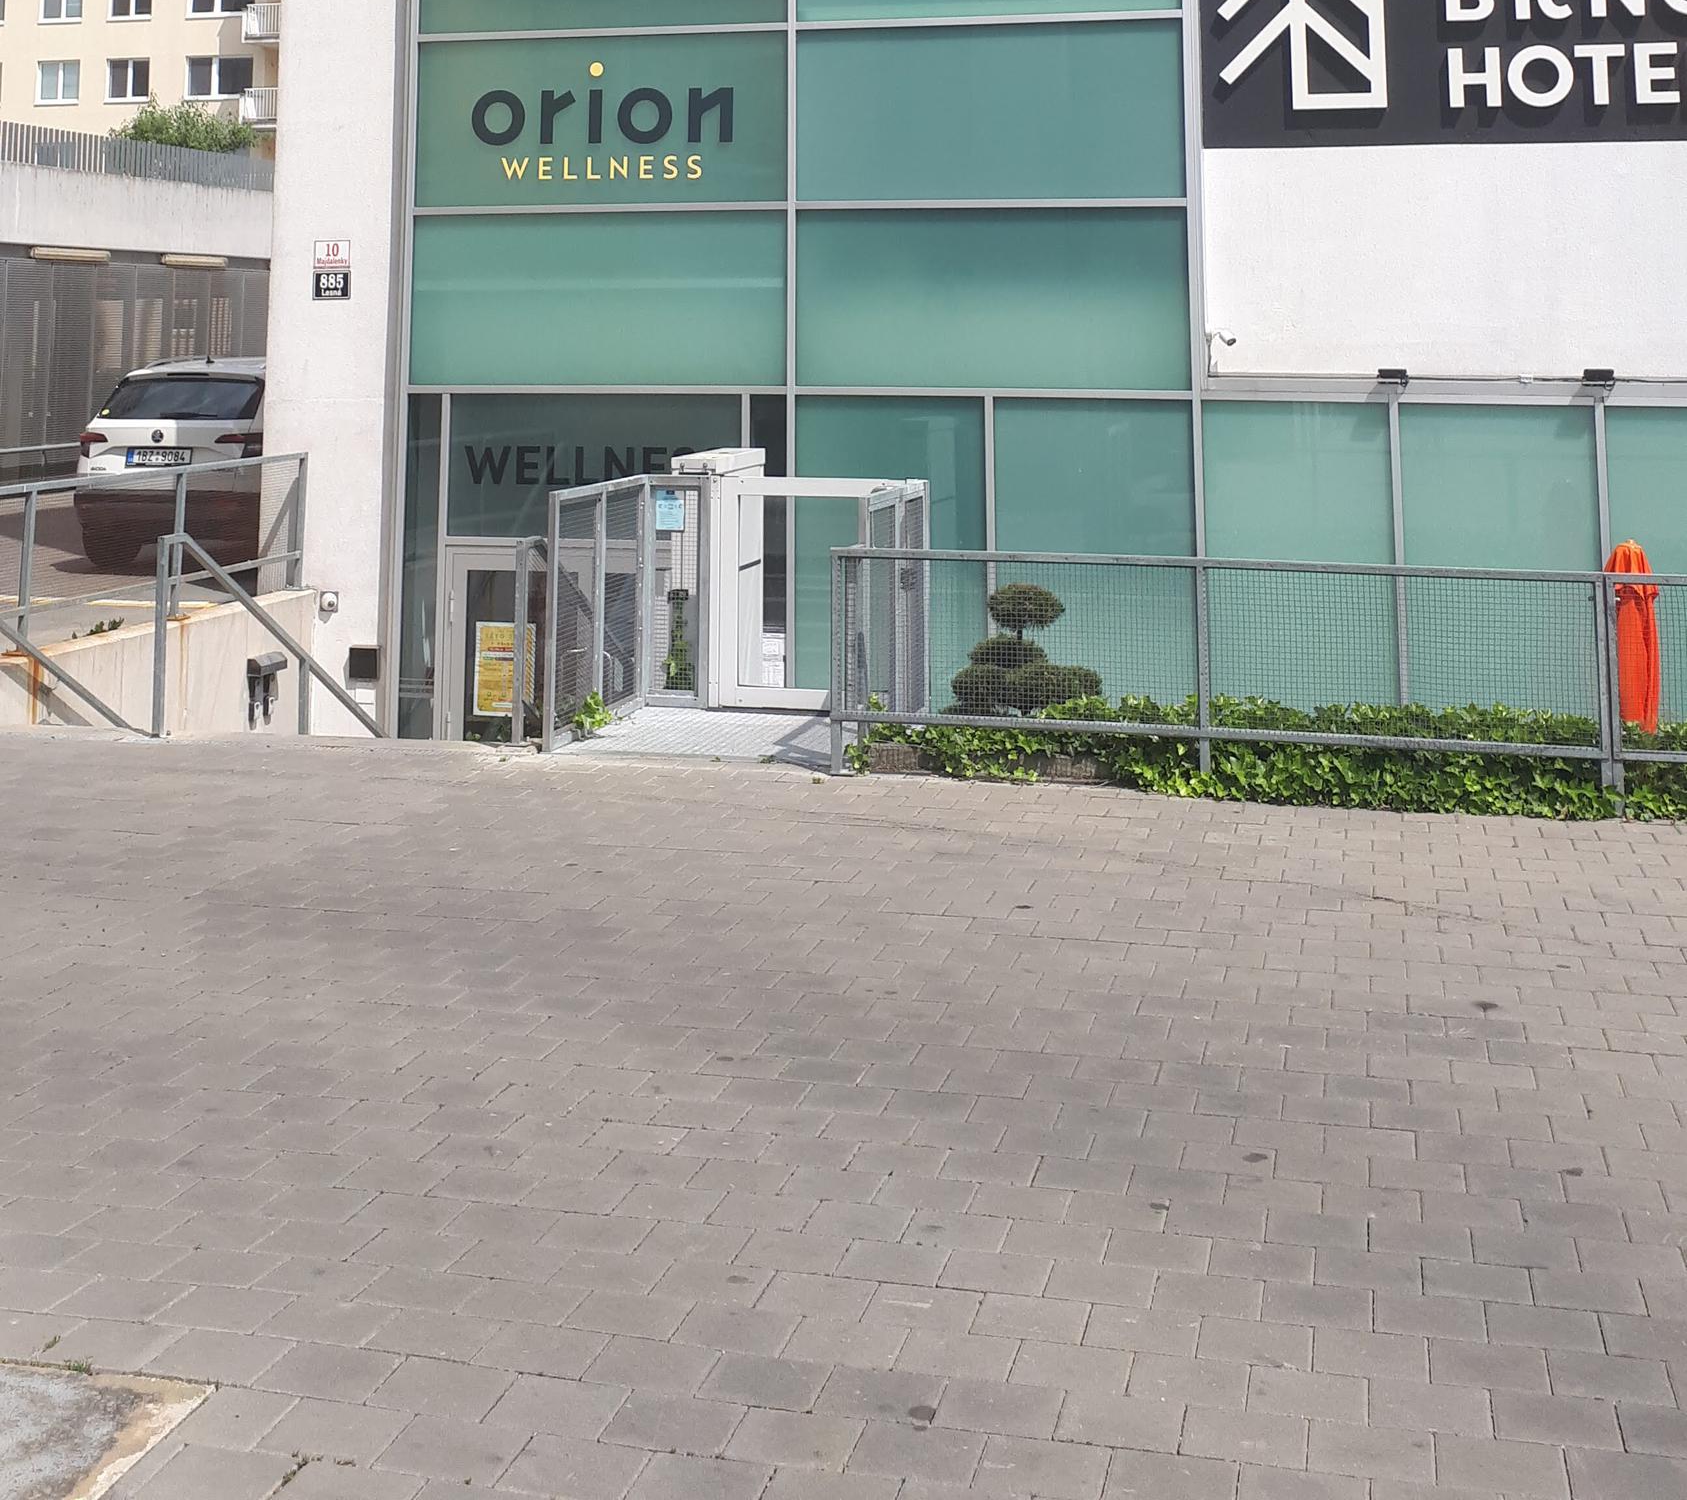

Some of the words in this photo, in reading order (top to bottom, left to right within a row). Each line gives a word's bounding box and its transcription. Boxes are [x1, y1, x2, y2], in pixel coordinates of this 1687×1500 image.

[471, 60, 734, 146] orion
[501, 154, 704, 181] WELLNESS
[325, 243, 340, 257] 10
[320, 273, 345, 289] 885
[136, 450, 154, 462] 1BZ
[160, 449, 186, 462] 9084
[465, 445, 724, 486] WELLNE
